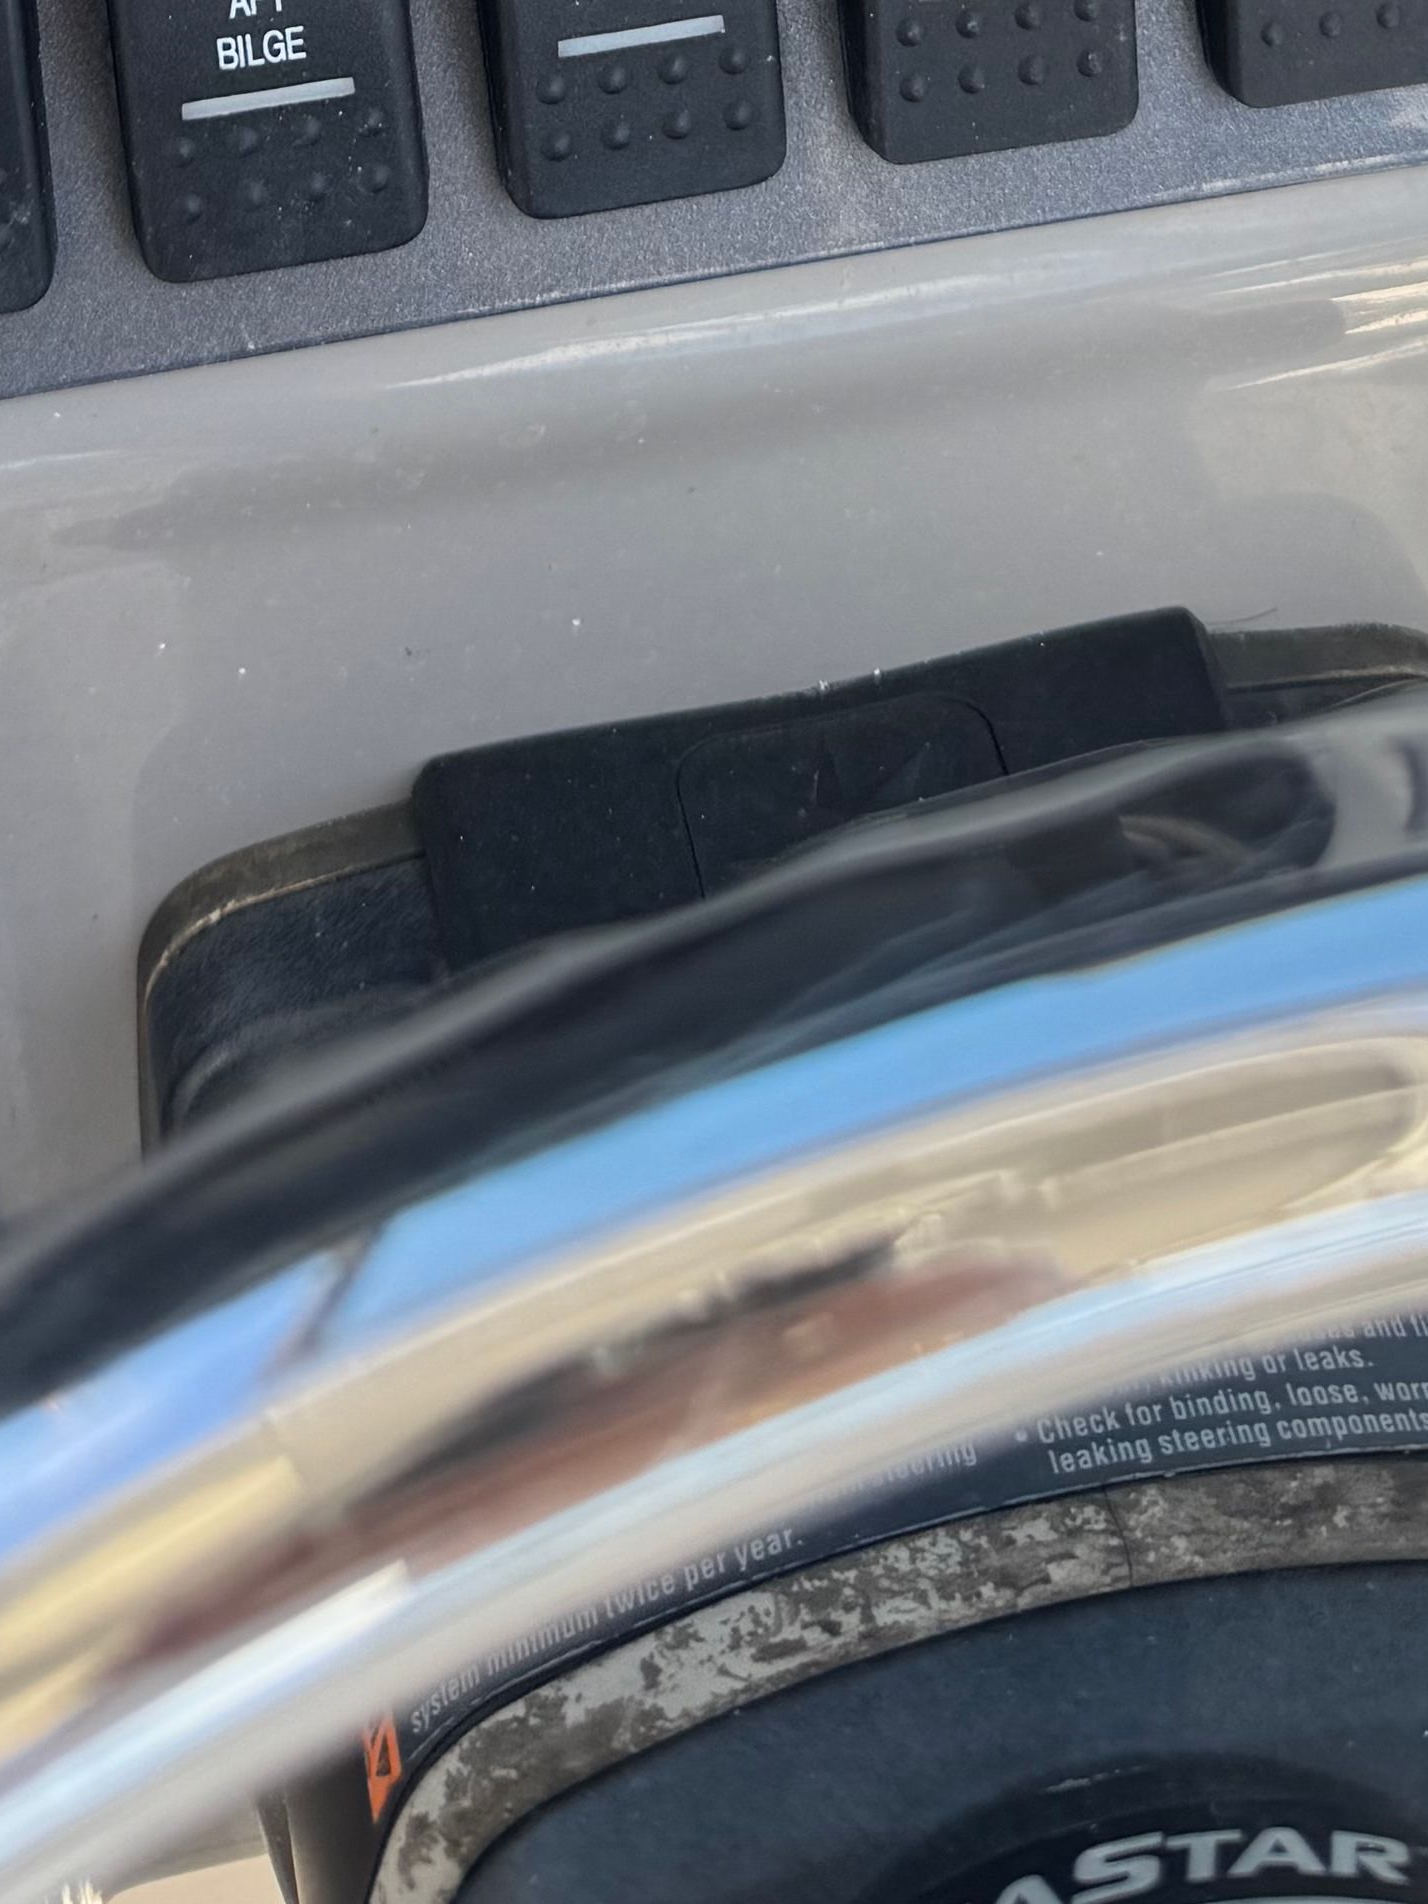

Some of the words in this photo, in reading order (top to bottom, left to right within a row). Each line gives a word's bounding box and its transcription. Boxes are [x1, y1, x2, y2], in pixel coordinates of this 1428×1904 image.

[217, 26, 306, 69] BILGE
[1364, 1312, 1407, 1339] and
[1261, 1353, 1288, 1374] or
[1293, 1343, 1374, 1371] leaks.
[1036, 1405, 1121, 1445] Check
[1124, 1402, 1163, 1428] for
[1170, 1386, 1282, 1421] binding,
[1285, 1381, 1370, 1408] loose,
[1047, 1434, 1153, 1475] leaking
[1159, 1419, 1271, 1456] steering
[682, 1552, 727, 1591] per
[733, 1527, 804, 1572] year.
